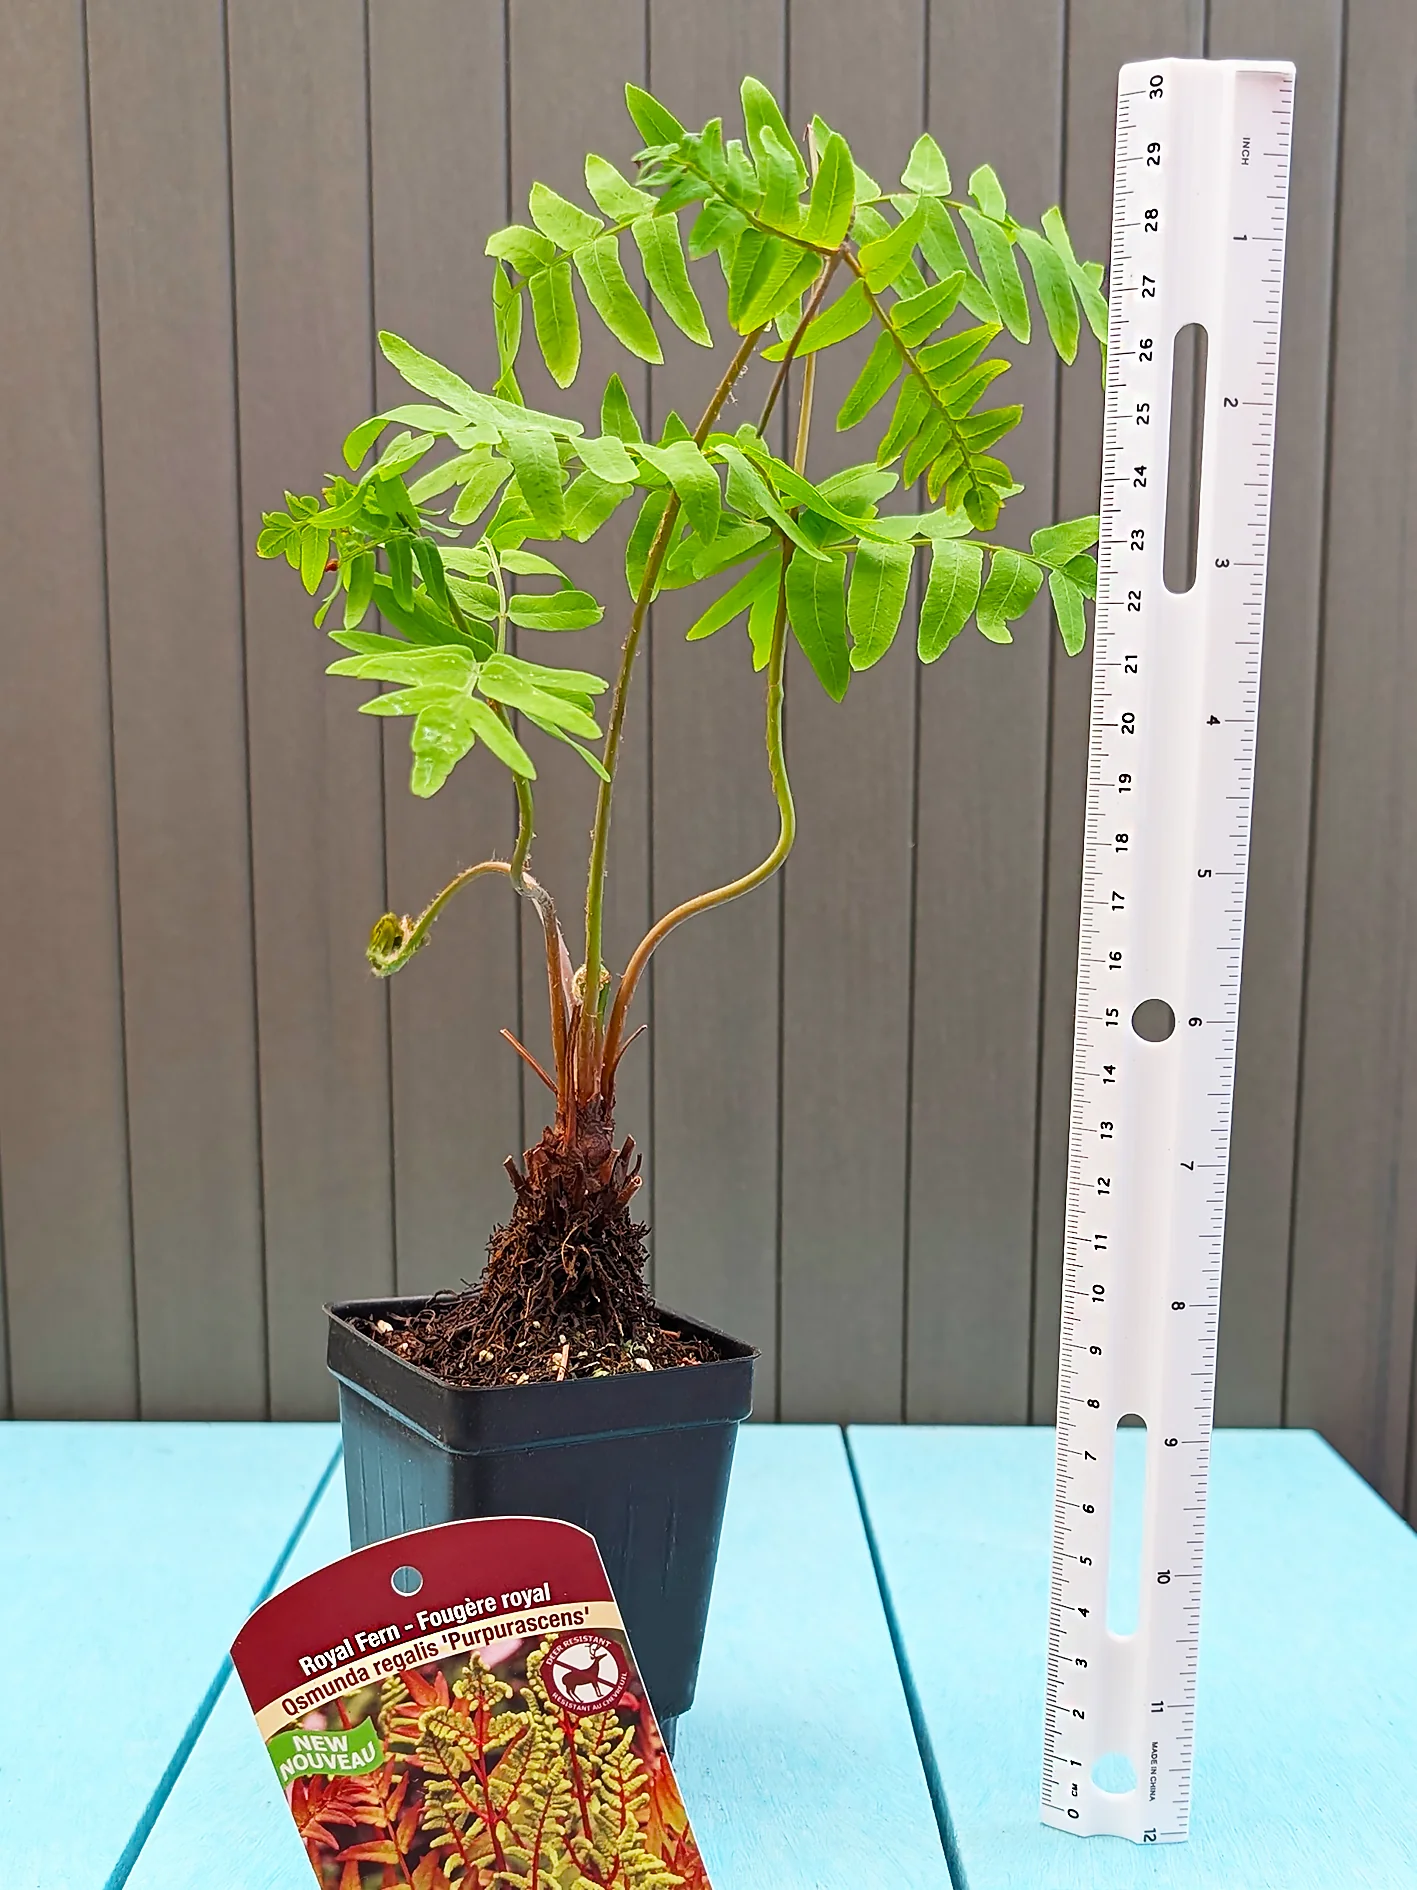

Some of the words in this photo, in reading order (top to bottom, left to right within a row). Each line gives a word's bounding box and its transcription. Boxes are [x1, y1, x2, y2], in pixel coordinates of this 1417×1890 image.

[1149, 75, 1163, 99] 30
[1147, 142, 1160, 166] 29
[1241, 138, 1250, 165] INCH
[1145, 209, 1158, 232] 28
[1142, 275, 1155, 298] 27
[1139, 339, 1153, 362] 26
[1224, 397, 1238, 407] 2
[1136, 403, 1150, 425] 25
[1133, 465, 1147, 488] 24
[1131, 529, 1144, 551] 23
[1215, 558, 1230, 568] 3
[1128, 591, 1141, 612] 22
[1125, 655, 1138, 674] 21
[1121, 712, 1135, 734] 20
[1206, 715, 1220, 726] 4
[1119, 774, 1131, 793] 19
[1115, 834, 1128, 853] 18
[1198, 869, 1211, 878] 5
[1112, 891, 1125, 911] 17
[1109, 951, 1122, 970] 16
[1106, 1008, 1119, 1027] 15
[1188, 1017, 1202, 1027] 6
[1103, 1065, 1116, 1084] 14
[1100, 1121, 1113, 1139] 13
[1180, 1161, 1194, 1171] 7
[1097, 1177, 1110, 1195] 12
[1094, 1235, 1107, 1250] 11
[1092, 1284, 1105, 1302] 10
[1171, 1301, 1185, 1310] 8
[1090, 1346, 1102, 1355] 9
[1087, 1399, 1100, 1409] 8
[1164, 1438, 1178, 1447] 9
[1085, 1451, 1096, 1460] 7
[1083, 1504, 1094, 1513] 6
[1080, 1556, 1092, 1566] 5
[1157, 1569, 1170, 1584] 10
[1078, 1608, 1089, 1617] 4
[298, 1638, 355, 1677] Royal
[354, 1624, 401, 1653] Fern
[416, 1596, 497, 1631] Fougère
[500, 1582, 551, 1609] royal
[373, 1641, 439, 1672] regalis
[442, 1606, 589, 1650] 'Purpurascens'
[545, 1645, 564, 1666] DEER
[562, 1635, 612, 1648] RESISTANT
[1075, 1658, 1087, 1668] 3
[592, 1702, 602, 1711] AU
[602, 1671, 628, 1707] CHEVREUIL
[1073, 1709, 1084, 1720] 2
[1151, 1701, 1164, 1712] 11
[292, 1734, 348, 1752] NEW
[280, 1740, 376, 1782] NOUVEAU
[1150, 1741, 1159, 1765] MADE
[1069, 1759, 1083, 1767] 1
[1150, 1766, 1157, 1775] IN
[1071, 1782, 1079, 1798] CM
[1148, 1776, 1157, 1802] CHINA
[1067, 1809, 1079, 1819] 0
[1143, 1828, 1157, 1842] 12
